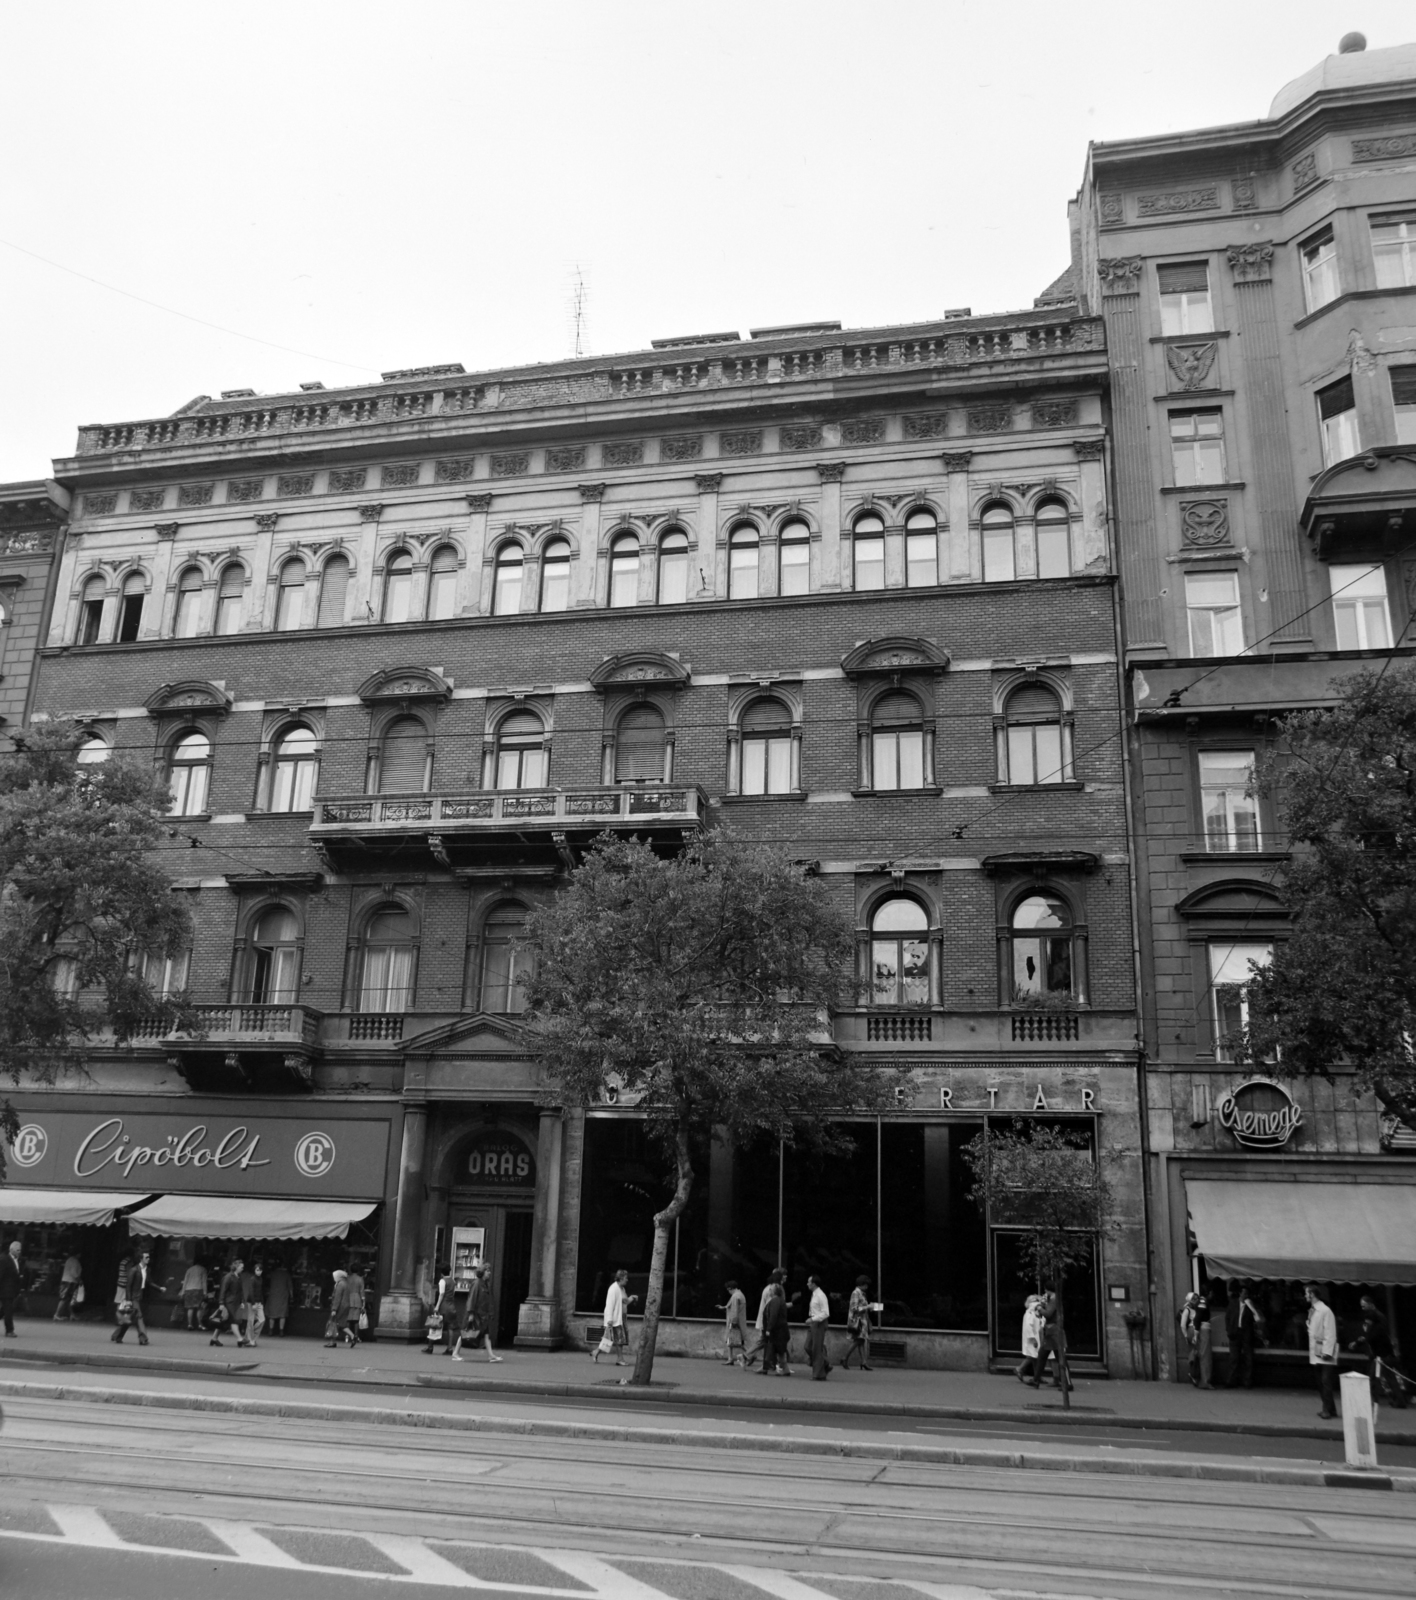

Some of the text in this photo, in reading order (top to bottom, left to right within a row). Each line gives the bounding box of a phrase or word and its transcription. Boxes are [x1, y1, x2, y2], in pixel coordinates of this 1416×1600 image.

[1219, 1096, 1302, 1140] Csemege
[74, 1118, 271, 1178] Cipőbolt
[468, 1149, 530, 1176] ÓRÁS
